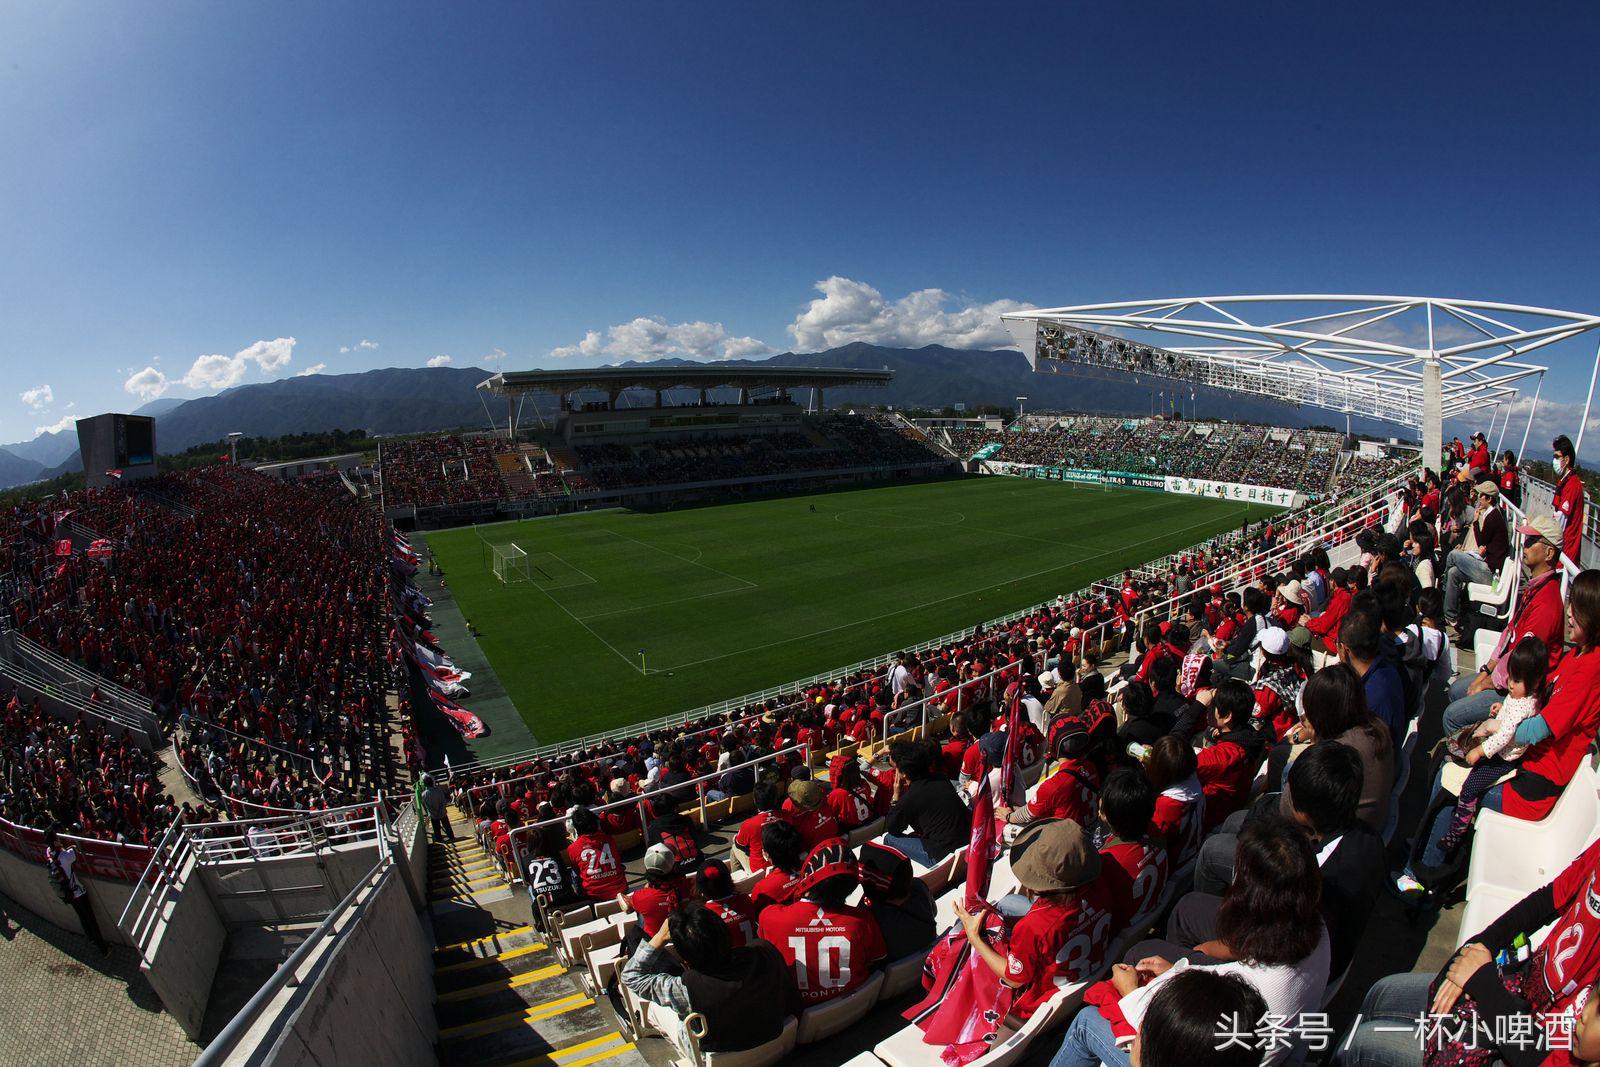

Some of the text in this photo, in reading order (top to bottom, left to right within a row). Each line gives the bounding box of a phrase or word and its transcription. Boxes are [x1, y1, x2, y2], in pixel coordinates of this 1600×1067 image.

[528, 859, 562, 889] 23
[580, 842, 617, 876] 24
[535, 884, 563, 894] TSUZUKI
[788, 935, 852, 990] 10
